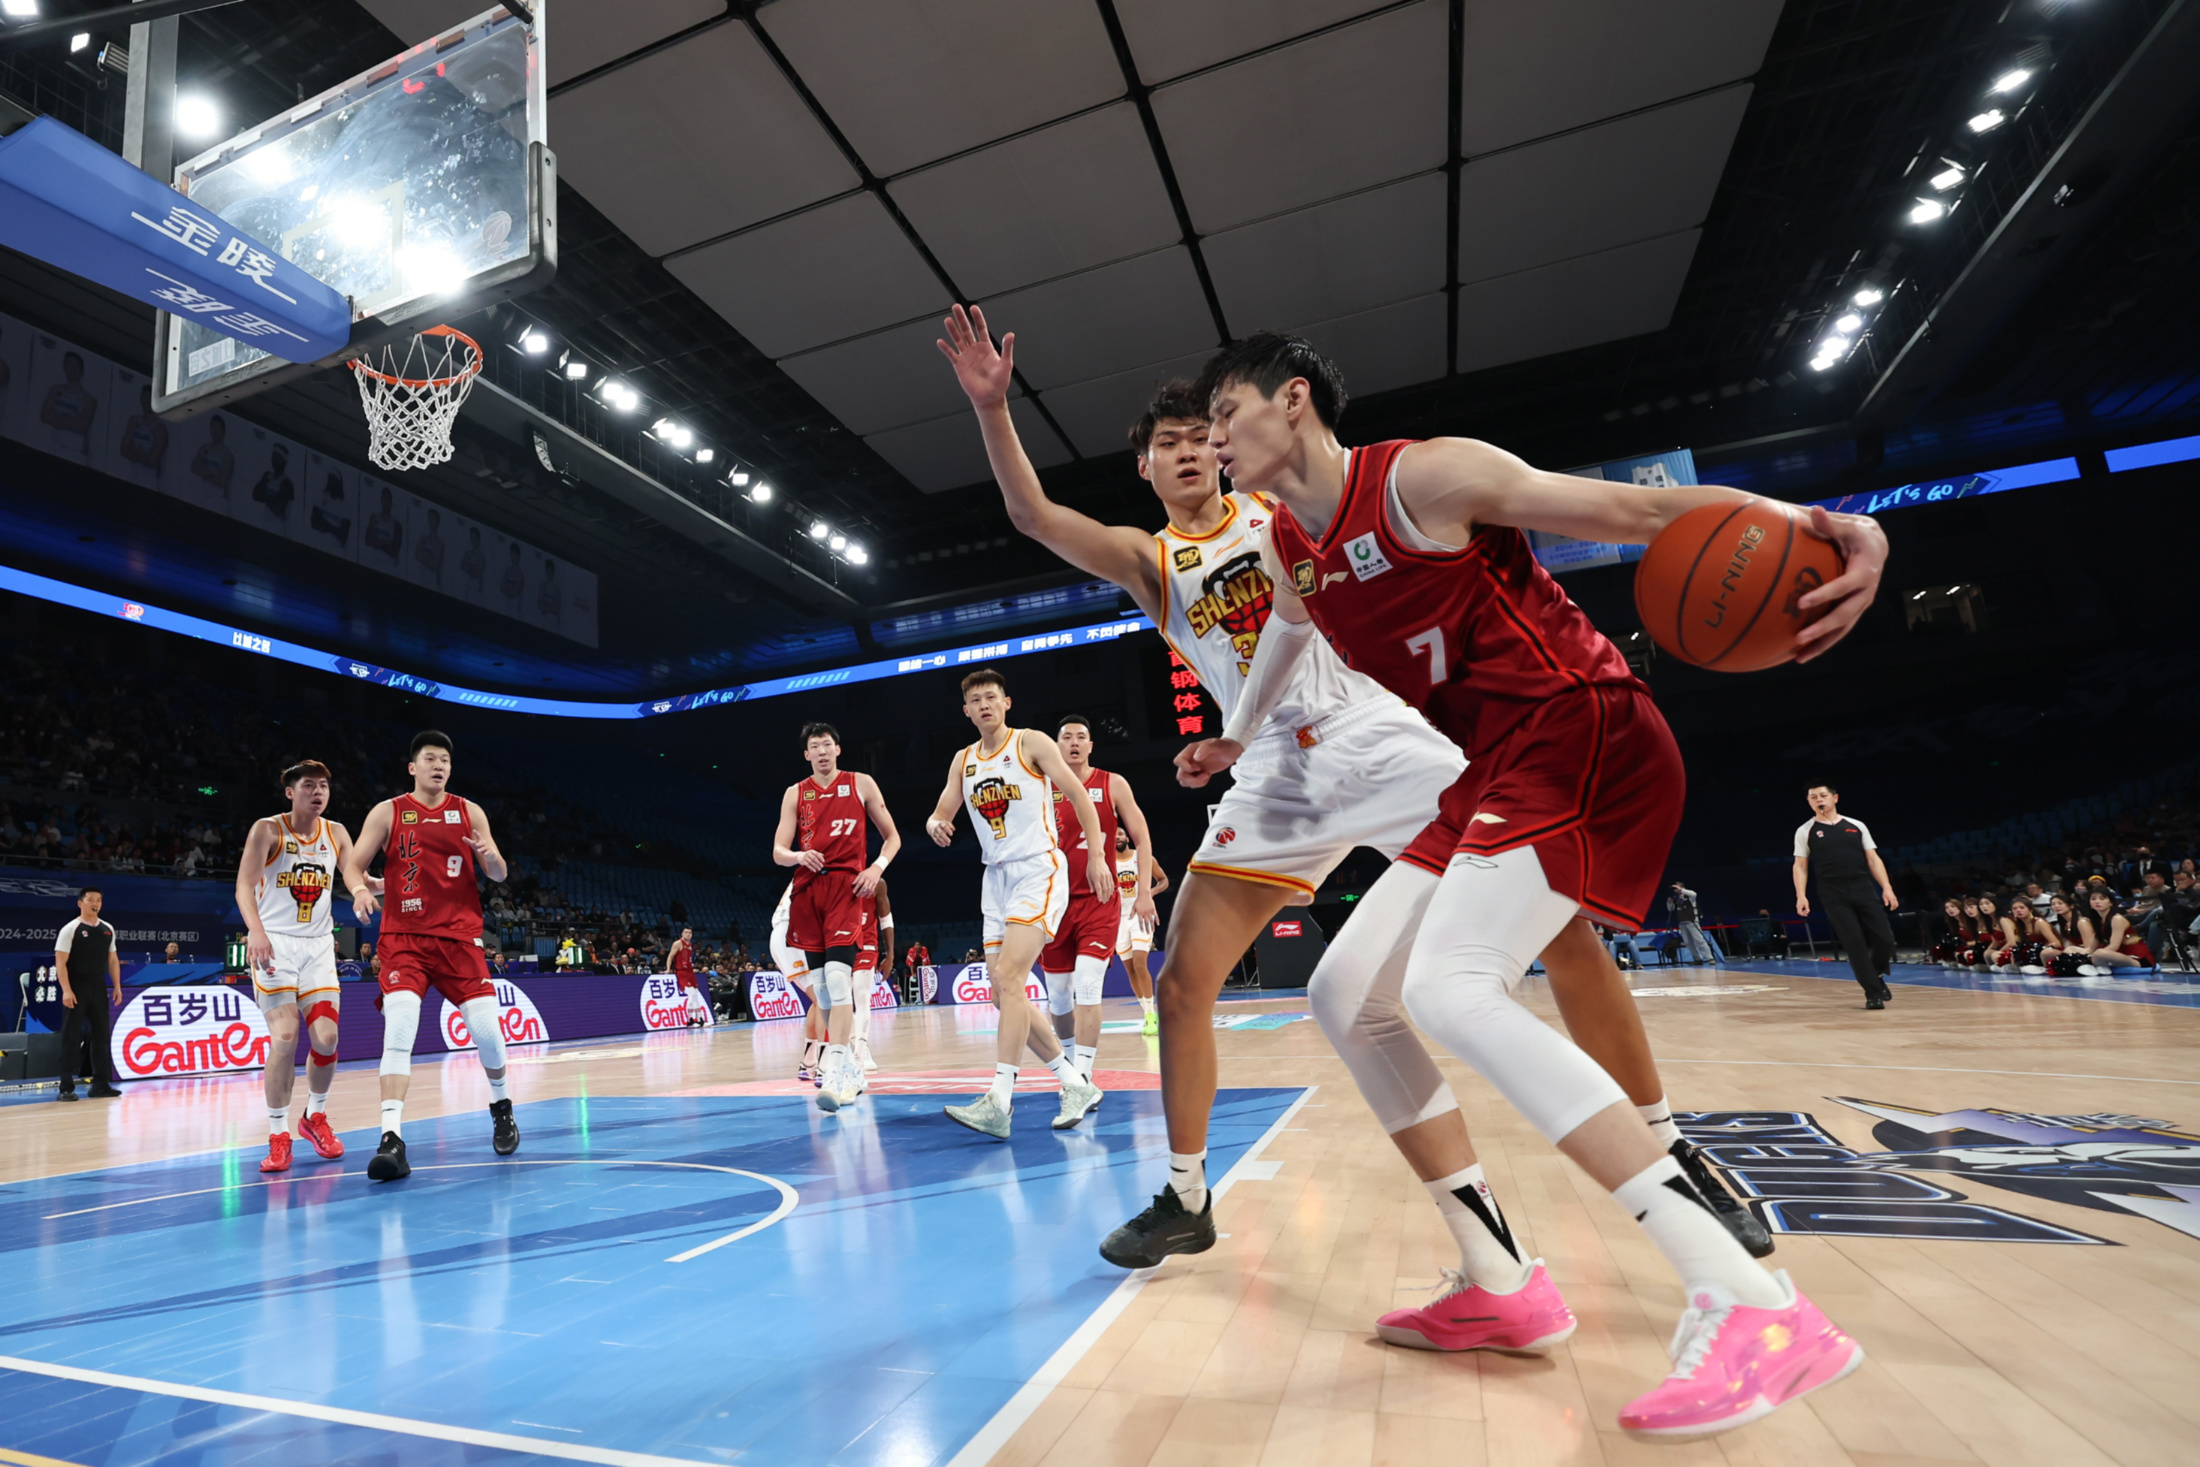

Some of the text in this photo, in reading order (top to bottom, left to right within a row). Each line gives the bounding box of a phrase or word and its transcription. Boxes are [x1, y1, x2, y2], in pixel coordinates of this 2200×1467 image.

[131, 206, 297, 305] 金陵
[1866, 484, 1953, 514] LET'S GO
[1704, 524, 1766, 629] LI-NING
[1185, 567, 1272, 639] SHENZ
[1405, 626, 1447, 685] 7
[388, 674, 427, 693] LET'S GO
[691, 690, 719, 710] LET'S
[720, 691, 734, 703] GO
[830, 818, 858, 837] 27
[990, 817, 1007, 840] 9
[447, 855, 463, 877] 9
[297, 902, 313, 923] 8
[401, 898, 422, 907] 1956
[755, 975, 786, 993] 百岁山
[142, 993, 241, 1027] 百岁山
